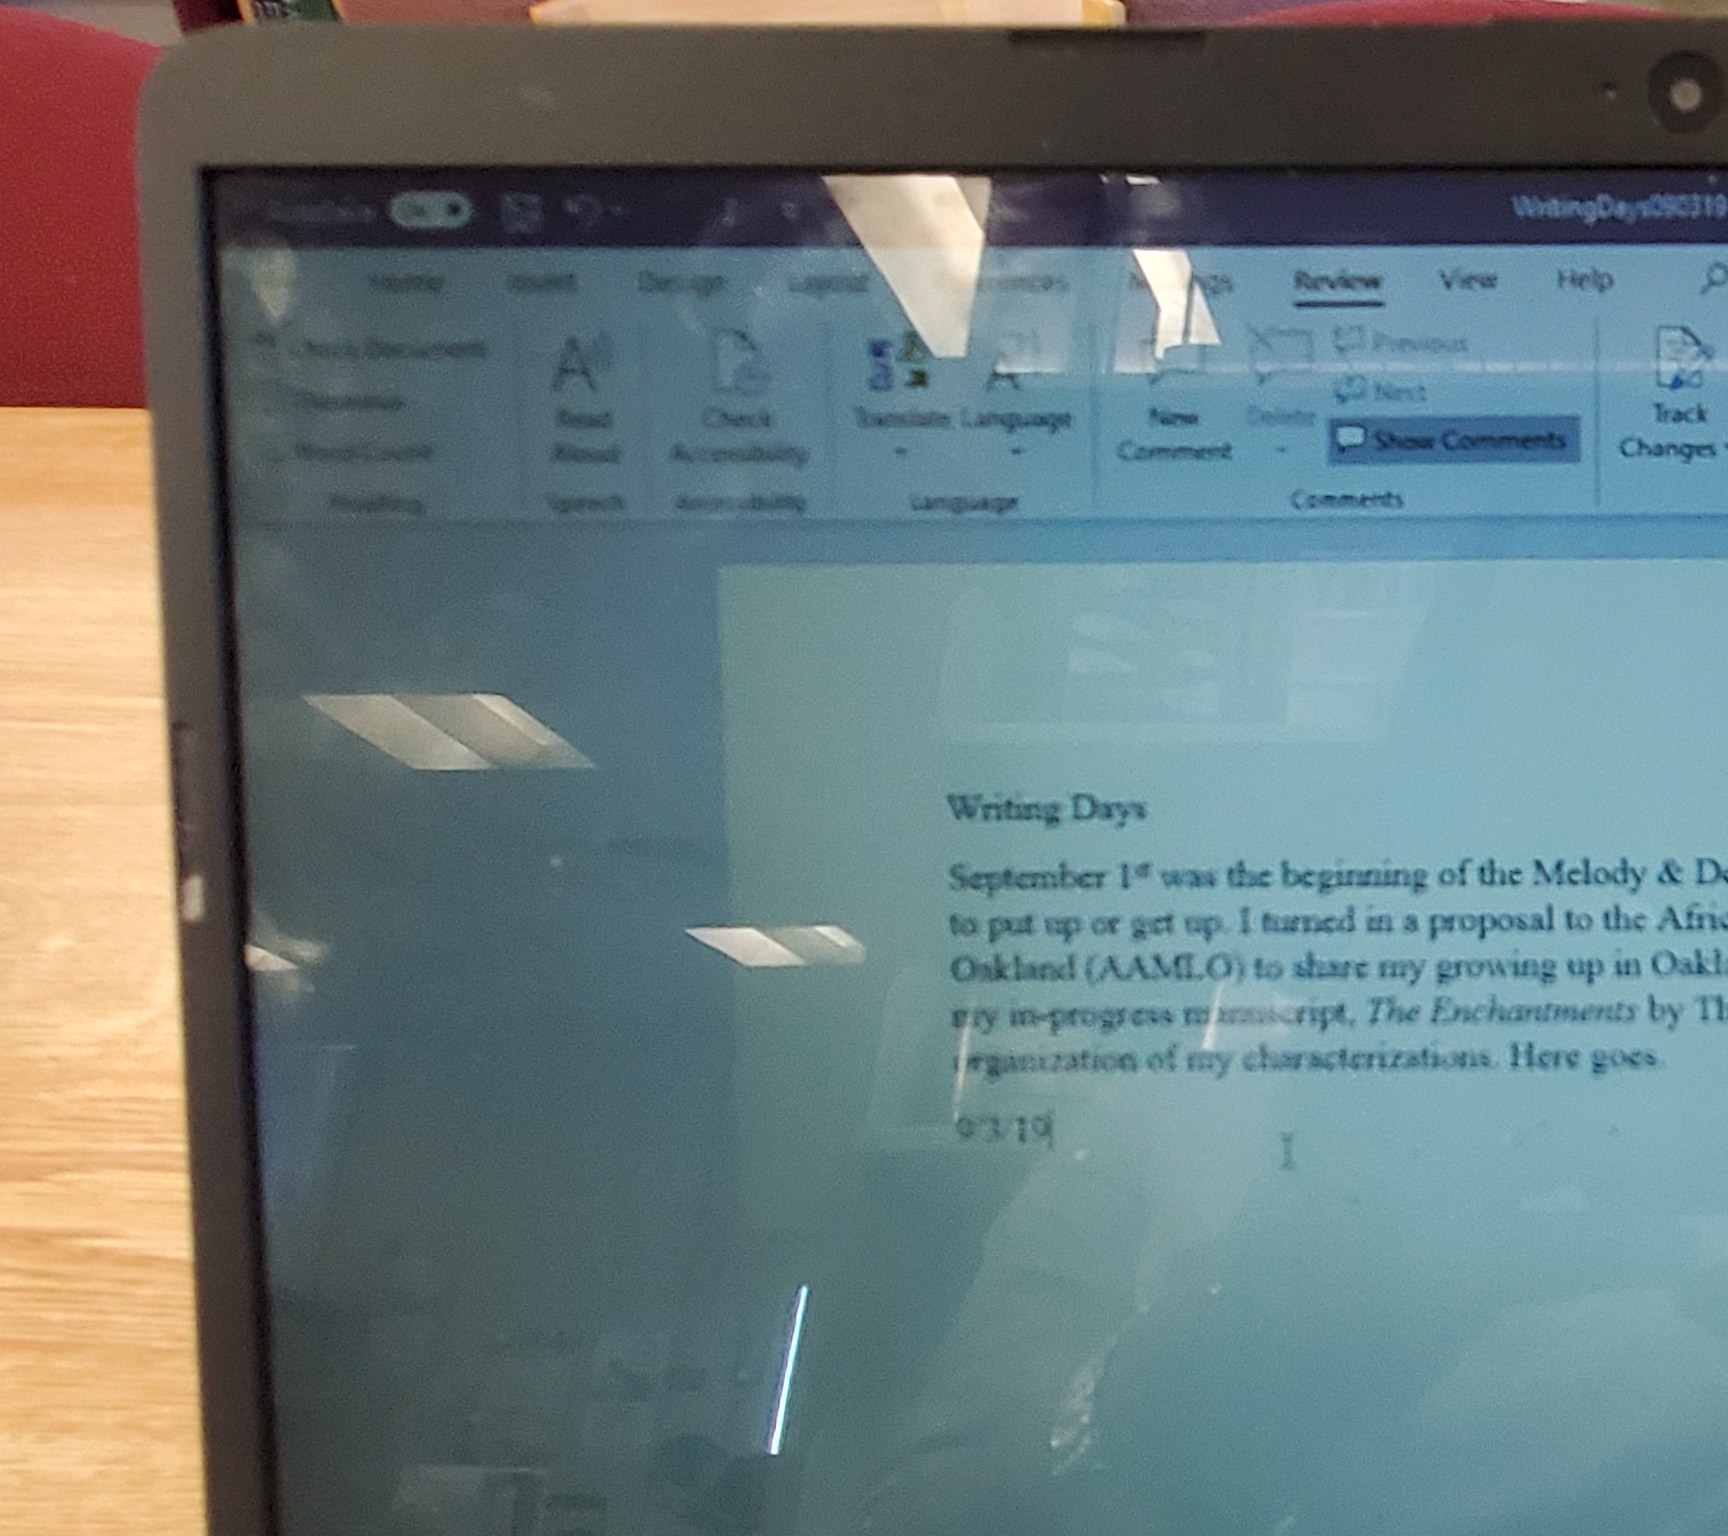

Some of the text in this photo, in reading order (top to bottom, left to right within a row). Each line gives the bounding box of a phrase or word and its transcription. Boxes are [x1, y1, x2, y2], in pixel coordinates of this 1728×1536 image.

[1294, 268, 1384, 293] Review
[1439, 268, 1499, 292] View
[1556, 267, 1616, 294] Help
[1652, 402, 1708, 425] Track
[1374, 429, 1568, 453] Show Comments
[1619, 438, 1718, 464] Changes
[1291, 488, 1404, 512] Comments
[947, 793, 1148, 827] Writing Days
[948, 861, 1106, 896] September
[1160, 867, 1214, 888] was
[1226, 859, 1270, 887] the
[1280, 859, 1430, 894] beginning
[1438, 858, 1471, 886] of
[1478, 858, 1523, 886] the
[1533, 857, 1647, 892] Melody
[1656, 857, 1683, 885] &
[949, 911, 977, 936] to
[987, 911, 1034, 944] put
[1044, 916, 1080, 943] up
[1090, 916, 1120, 935] or
[1130, 909, 1175, 942] get
[1238, 909, 1252, 934] I
[1261, 908, 1356, 933] turned
[1365, 908, 1392, 933] in
[1403, 914, 1418, 933] a
[1429, 907, 1554, 940] proposal
[1565, 906, 1592, 931] to
[1602, 906, 1648, 931] the
[950, 956, 1077, 982] Oakland
[1085, 954, 1246, 980] (AAMLO)
[1254, 954, 1284, 980] to
[1294, 953, 1369, 979] share
[1379, 961, 1424, 987] my
[1434, 952, 1556, 986] growing
[1567, 959, 1603, 985] up
[1614, 951, 1641, 977] in
[951, 1011, 998, 1037] my
[1009, 1003, 1173, 1036] in-progress
[1369, 1000, 1421, 1025] The
[1431, 999, 1637, 1024] Enchantments
[1648, 998, 1683, 1031] by
[1145, 1045, 1177, 1070] of
[1186, 1051, 1232, 1078] my
[1508, 1042, 1580, 1067] Here
